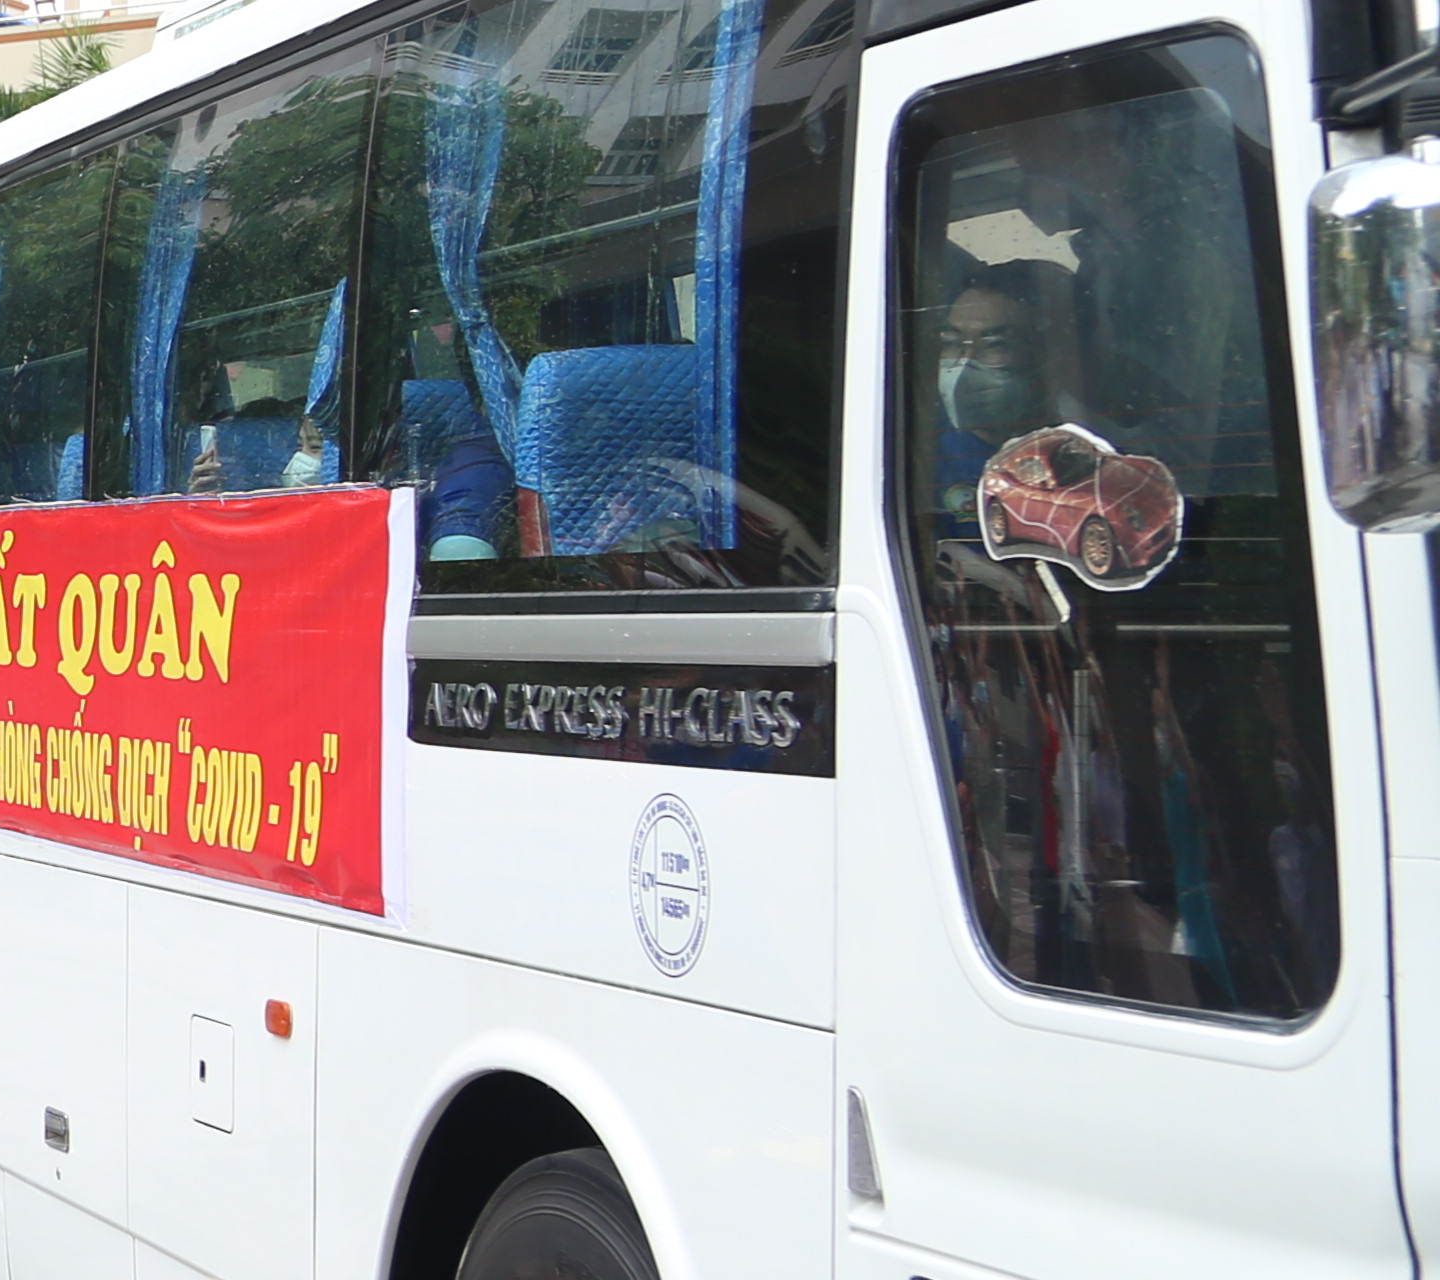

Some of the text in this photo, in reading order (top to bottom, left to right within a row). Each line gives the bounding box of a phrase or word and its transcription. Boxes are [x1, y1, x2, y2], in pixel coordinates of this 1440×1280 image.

[57, 540, 241, 696] QUÂN
[46, 699, 114, 824] CHỐNG
[117, 737, 171, 851] DỊCH
[424, 682, 802, 749] AERO EXPRESS HI-CLASS
